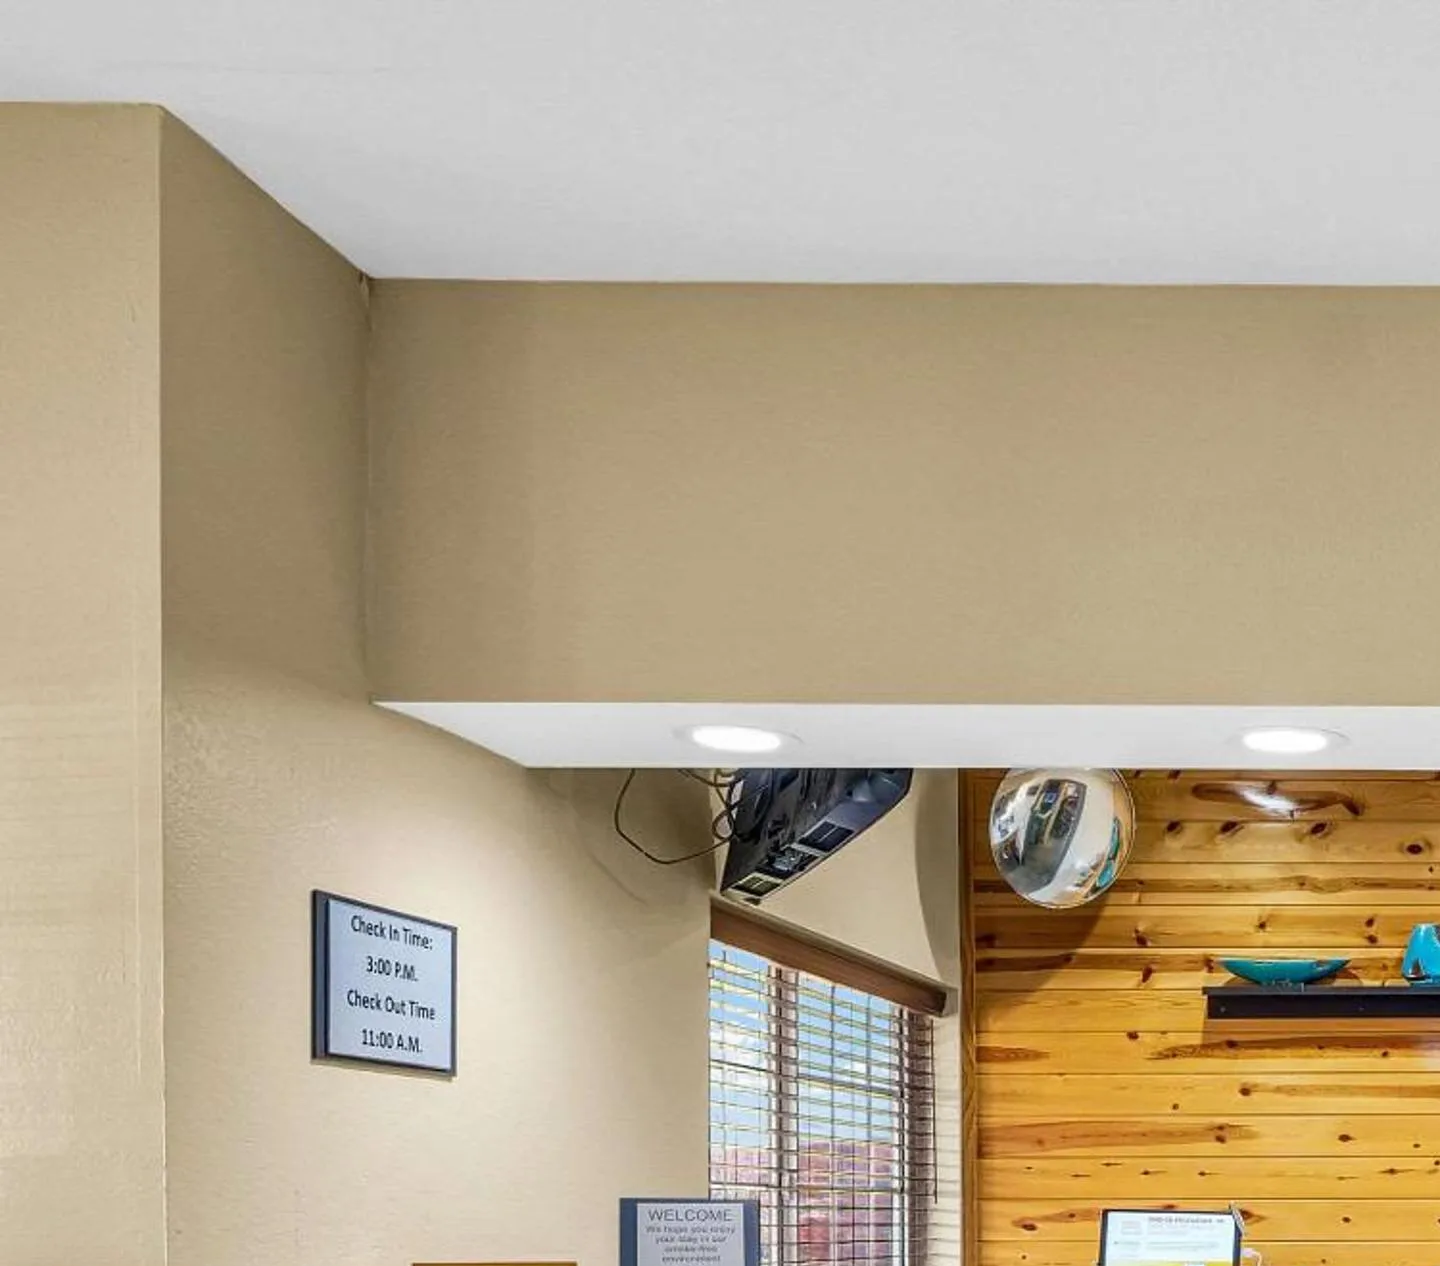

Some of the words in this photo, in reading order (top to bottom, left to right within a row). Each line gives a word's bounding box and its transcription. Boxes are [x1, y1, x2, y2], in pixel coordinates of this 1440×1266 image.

[351, 914, 386, 937] Check
[389, 924, 400, 941] In
[403, 928, 434, 950] Time:
[366, 956, 391, 976] 3:00
[394, 962, 418, 982] P.M.
[347, 989, 382, 1010] Check
[385, 996, 406, 1016] Out
[409, 1001, 435, 1020] Time
[361, 1029, 394, 1049] 11:00
[397, 1034, 423, 1053] A.M.
[648, 1208, 733, 1222] WELCOME
[691, 1226, 708, 1235] you
